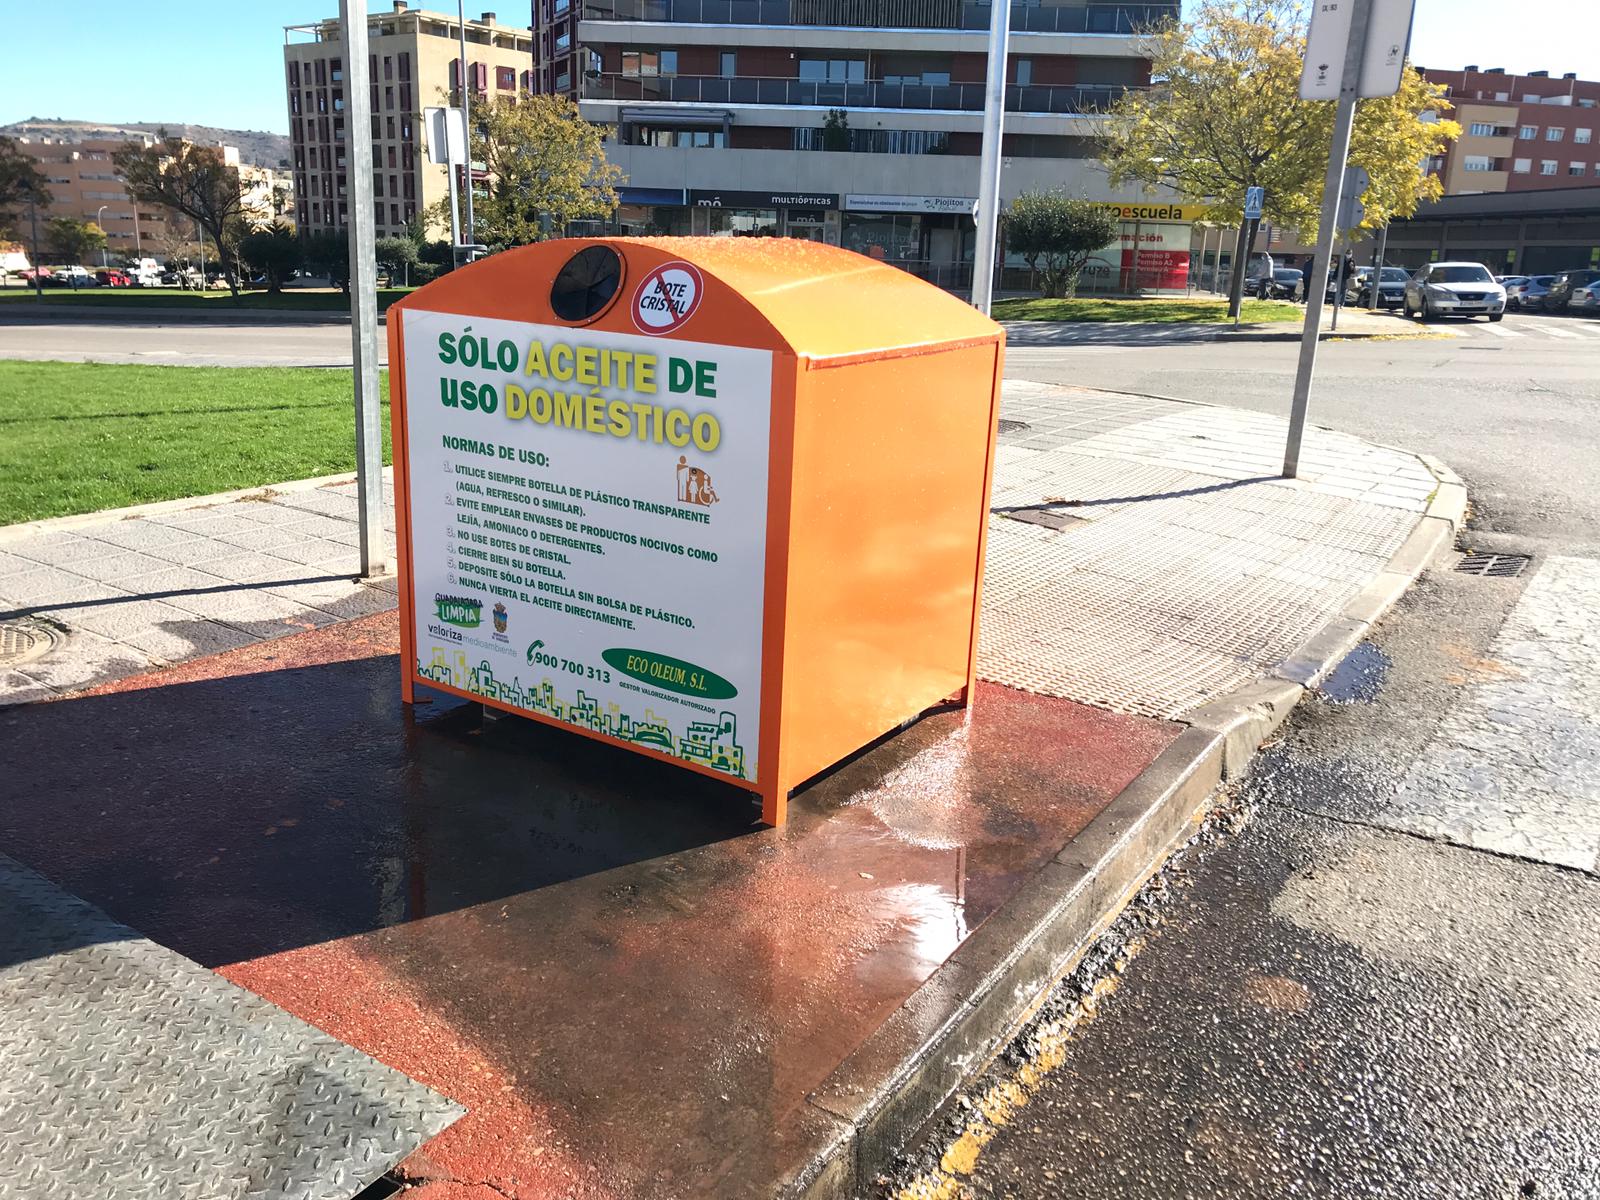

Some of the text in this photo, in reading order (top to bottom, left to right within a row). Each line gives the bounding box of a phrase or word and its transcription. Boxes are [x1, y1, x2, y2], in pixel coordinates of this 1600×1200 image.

[640, 296, 685, 315] CRISTAL
[654, 280, 687, 298] BOTE
[438, 326, 717, 398] SÓLO ACEITE DE
[505, 384, 720, 452] DOMÉSTICO
[442, 435, 550, 468] NORMAS DE USO:
[455, 464, 486, 479] UTILICE
[488, 472, 526, 487] SIEMPRE
[528, 478, 567, 496] BOTELLA
[570, 486, 582, 499] DE
[584, 490, 630, 508] PLÁSTICO
[633, 500, 710, 524] TRANSPARENTE
[456, 481, 586, 518] (AGUA, REFRESCO O SIMILAR).
[456, 497, 479, 511] EVITE
[481, 502, 521, 520] EMPLEAR
[523, 509, 563, 528] ENVASES
[566, 518, 578, 532] DE
[580, 523, 637, 545] PRODUCTOS
[640, 536, 684, 556] NOCIVOS
[687, 547, 718, 563] COMO
[457, 530, 470, 541] NO
[472, 533, 488, 544] USE
[490, 537, 517, 552] BOTES
[519, 543, 531, 555] DE
[533, 547, 571, 565] CRISTAL.
[483, 519, 529, 537] AMONIACO
[531, 530, 538, 540] O
[540, 531, 606, 556] DETERGENTES.
[458, 546, 488, 559] CIERRE
[490, 551, 510, 564] BIEN
[512, 556, 524, 567] SU
[526, 560, 566, 580] BOTELLA.
[441, 604, 477, 623] LIMPIA
[458, 561, 498, 578] DEPOSITE
[500, 567, 522, 584] SÓLO
[525, 577, 536, 588] LA
[538, 579, 576, 599] BOTELLA
[578, 590, 594, 603] SIN
[596, 595, 627, 612] BOLSA
[630, 604, 643, 616] DE
[645, 607, 696, 629] PLÁSTICO.
[459, 577, 487, 592] NUNCA
[489, 585, 518, 600] VIERTA
[520, 592, 531, 603] EL
[532, 595, 562, 611] ACEITE
[565, 602, 636, 631] DIRECTAMENTE.
[535, 652, 611, 684] 900 700 313
[627, 655, 648, 674] ECO
[690, 673, 707, 692] S.L.
[619, 681, 716, 714] GESTOR VALORIZADOR AUTORIZADO
